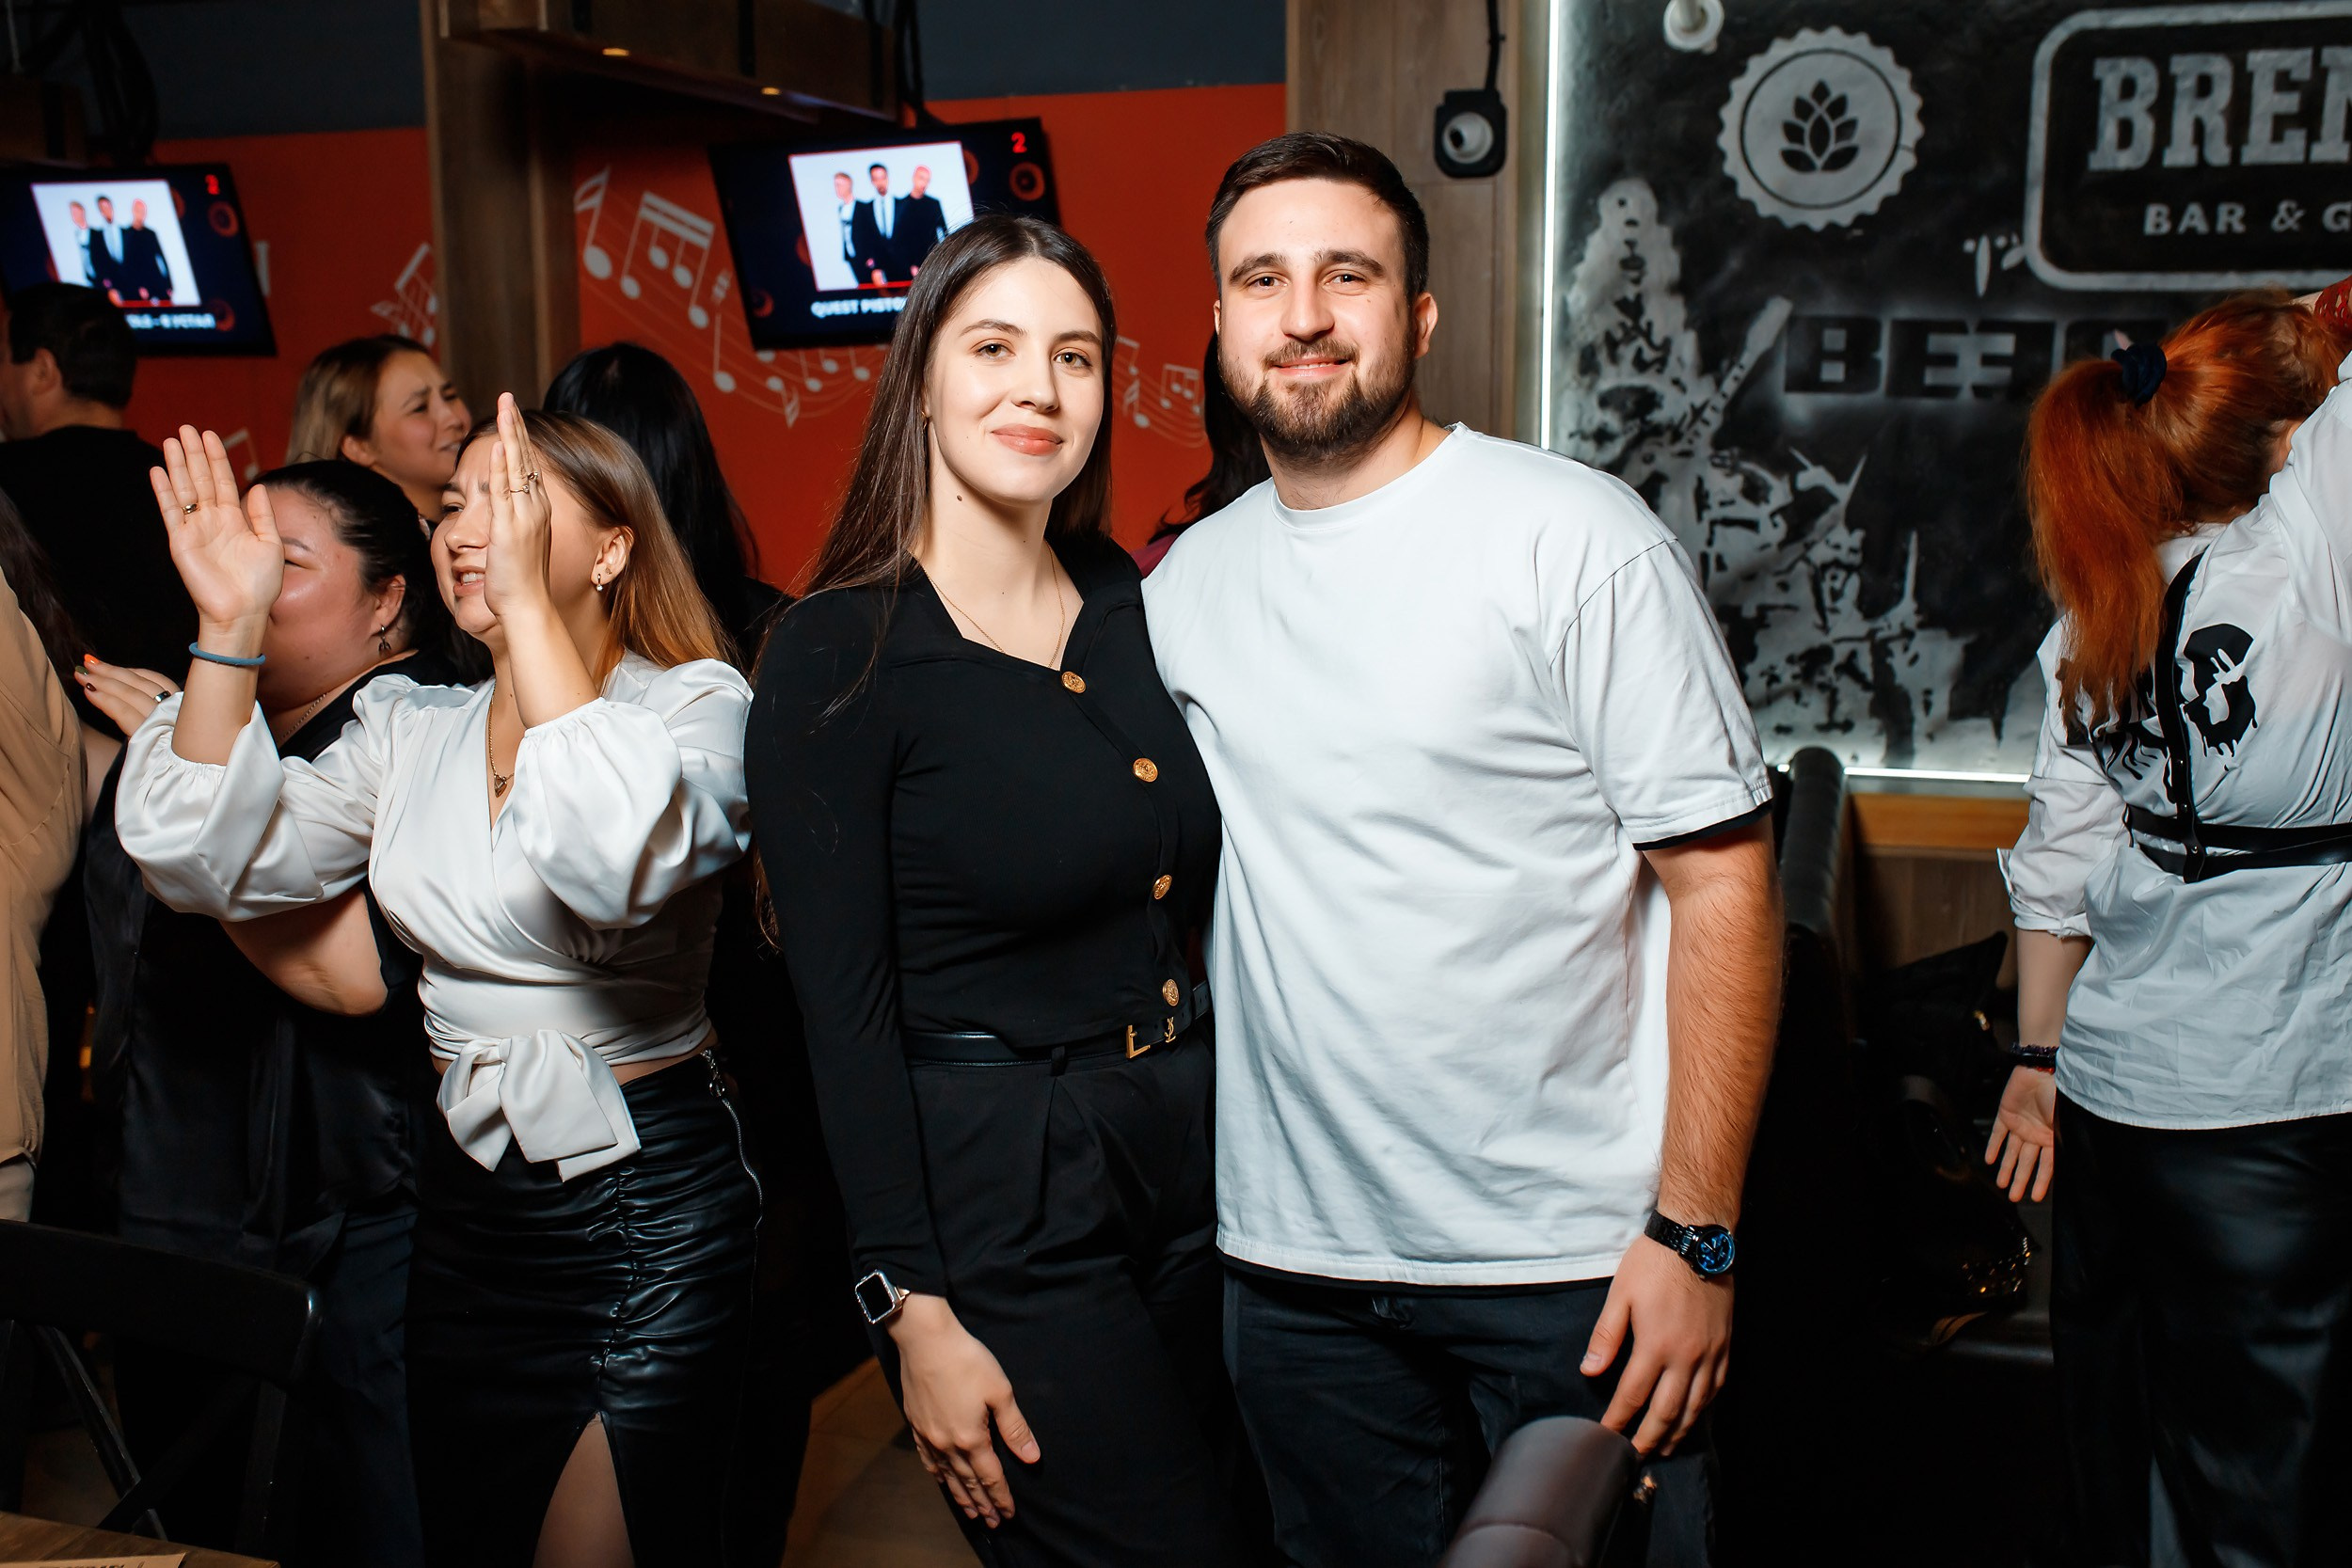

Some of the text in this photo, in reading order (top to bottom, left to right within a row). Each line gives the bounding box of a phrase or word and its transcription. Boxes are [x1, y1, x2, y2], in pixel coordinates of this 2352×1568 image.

[1010, 132, 1027, 152] 2
[2144, 201, 2247, 235] BAR
[2271, 199, 2304, 232] &
[811, 299, 859, 319] QUEST
[1785, 315, 2169, 398] BEE
